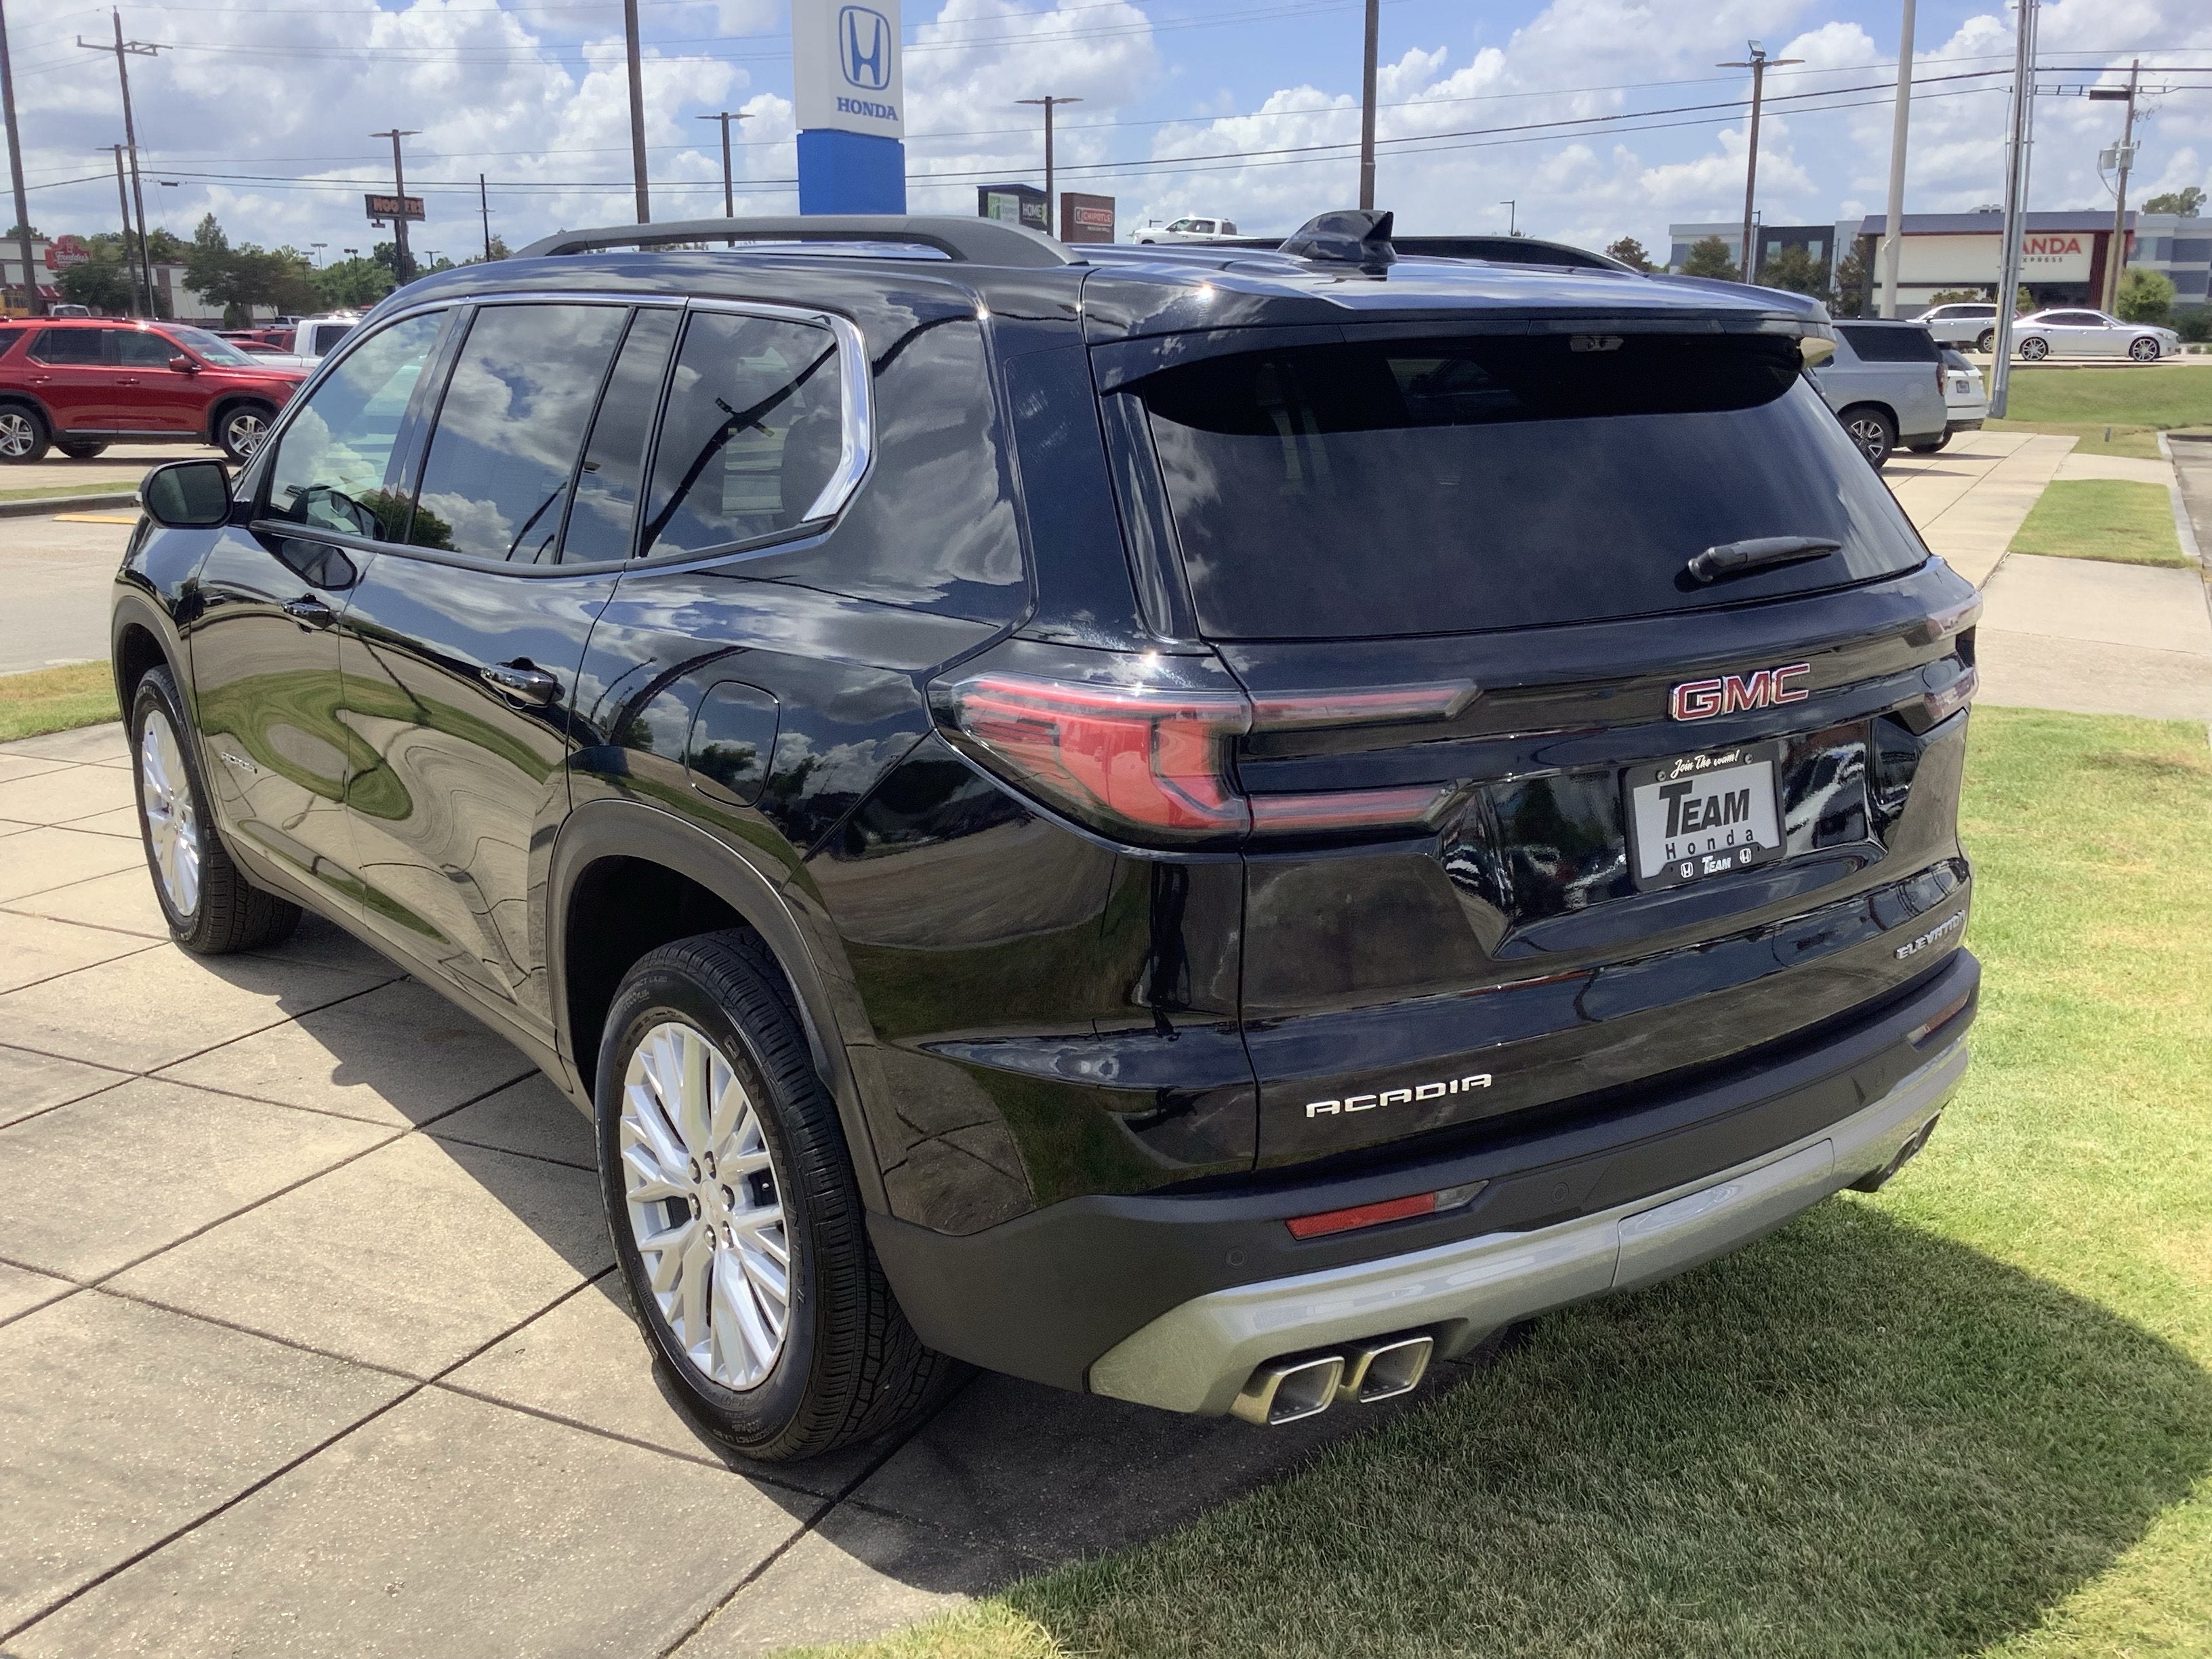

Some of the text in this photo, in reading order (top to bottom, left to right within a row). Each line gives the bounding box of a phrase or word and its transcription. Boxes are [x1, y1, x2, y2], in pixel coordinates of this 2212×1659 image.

[836, 96, 899, 121] HONDA
[372, 197, 424, 214] HOOERS
[2001, 237, 2082, 255] ANDA
[1671, 663, 1811, 721] GMC
[1670, 758, 1694, 779] Join
[1694, 754, 1712, 770] The
[1659, 780, 1750, 839] TEAM
[1665, 829, 1754, 860] Honda
[1701, 855, 1732, 875] TEAM
[1305, 1073, 1492, 1118] ACADIA
